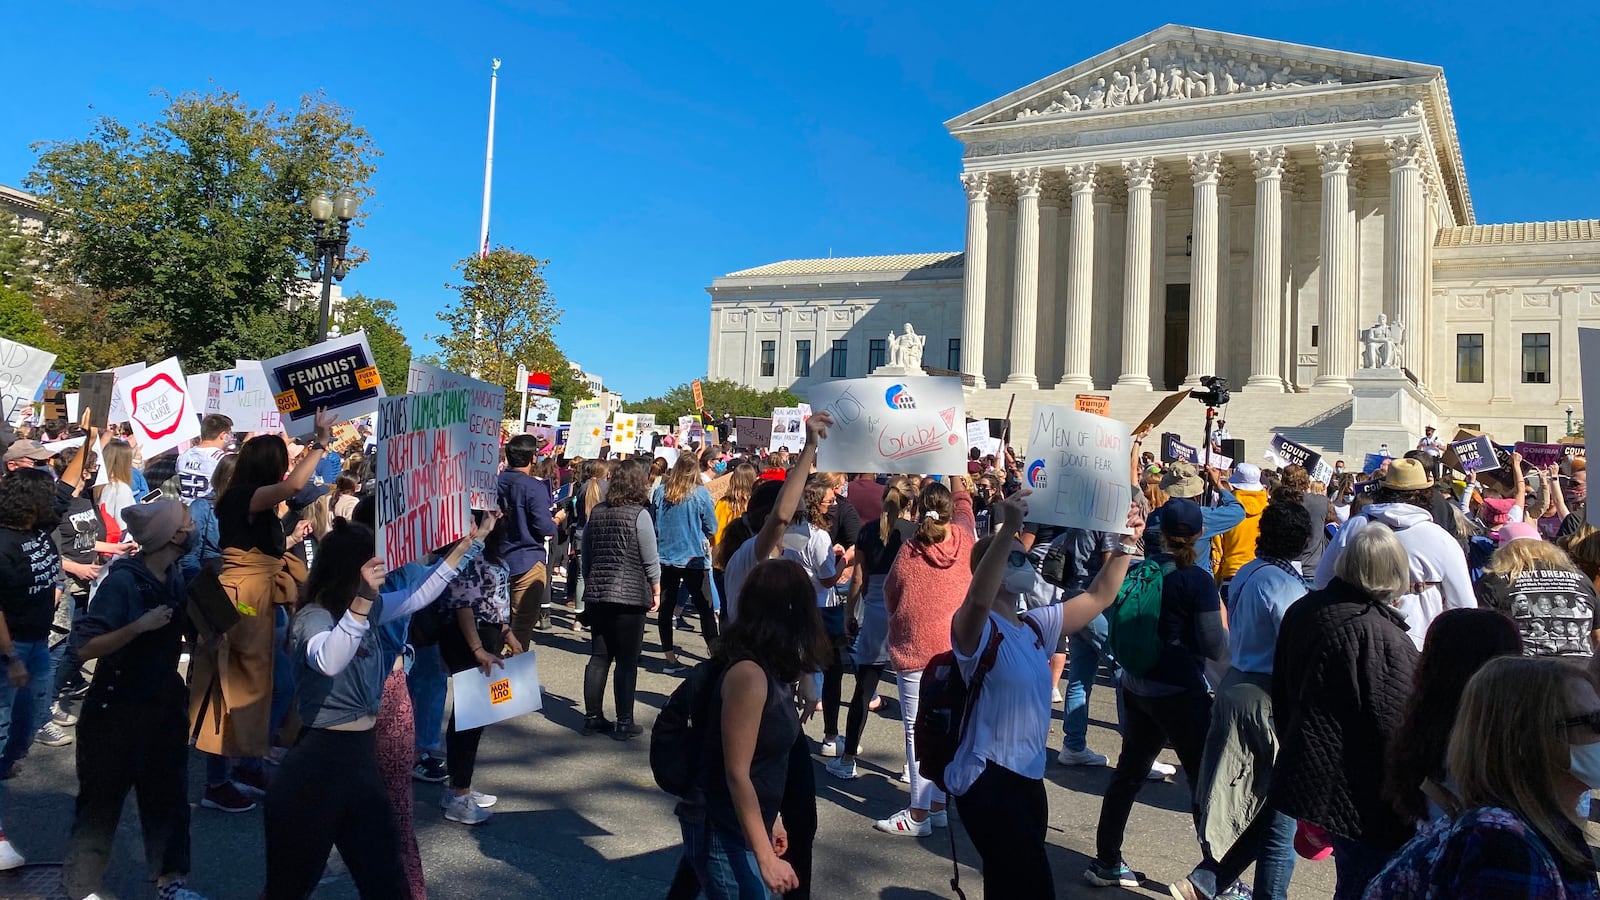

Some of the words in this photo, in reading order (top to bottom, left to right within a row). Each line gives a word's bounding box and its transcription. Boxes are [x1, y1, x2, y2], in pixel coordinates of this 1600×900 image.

[288, 355, 357, 387] FEMINIST
[304, 373, 351, 396] VOTER
[409, 368, 426, 394] IF
[277, 394, 294, 405] OUT
[279, 401, 299, 412] NOW
[826, 384, 865, 431] NOT
[1079, 399, 1107, 409] Trump/
[379, 396, 408, 441] DENIES
[411, 391, 441, 432] CLIMATE
[1080, 406, 1104, 415] Pence
[868, 416, 881, 433] for
[1078, 431, 1089, 447] OF
[387, 431, 416, 476] RIGHT
[417, 430, 427, 466] TO
[480, 443, 494, 465] IS
[1280, 449, 1291, 460] ON
[1292, 456, 1304, 467] US
[1281, 441, 1310, 460] COUNT
[1469, 450, 1480, 460] US
[1523, 446, 1559, 455] CONFIRM
[185, 461, 202, 471] MACK
[1095, 456, 1112, 472] FEAR
[378, 472, 406, 529] DENIES
[385, 509, 417, 572] RIGHT
[417, 500, 434, 556] TO
[434, 493, 463, 549] JAIL!
[490, 681, 510, 694] NOW
[493, 689, 509, 700] OUT
